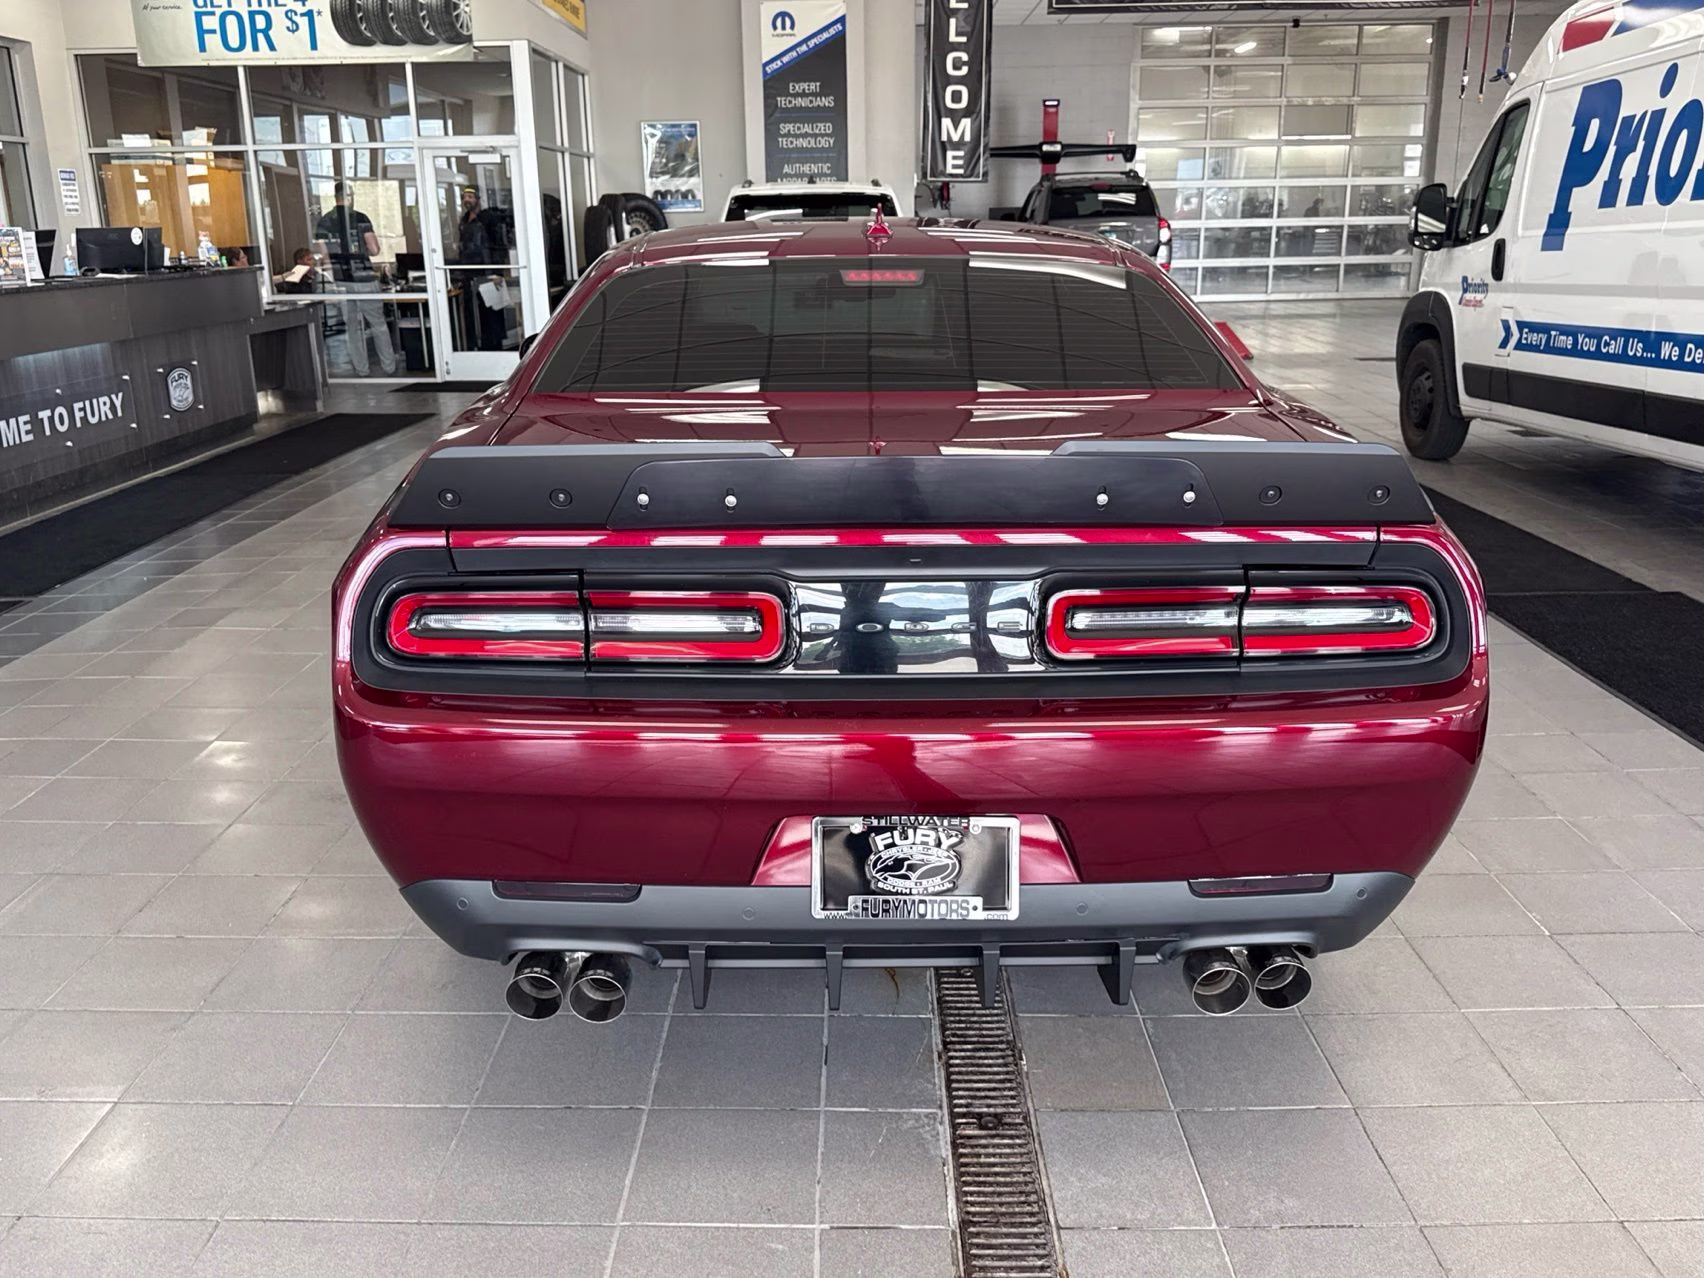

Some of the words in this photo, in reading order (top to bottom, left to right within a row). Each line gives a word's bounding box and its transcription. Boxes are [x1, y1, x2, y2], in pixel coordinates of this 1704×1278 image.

[194, 9, 276, 53] FOR
[765, 59, 784, 75] STICK
[780, 49, 799, 65] WITH
[796, 43, 809, 55] THE
[807, 22, 843, 49] SPECIALISTS
[789, 82, 821, 94] EXPERT
[776, 96, 834, 108] TECHNICIANS
[779, 122, 833, 135] SPECIALIZED
[778, 137, 835, 149] TECHNOLOGY
[783, 163, 831, 174] AUTHENTIC
[1521, 328, 1547, 350] Every
[1550, 330, 1573, 349] Time
[1577, 333, 1597, 351] You
[1601, 335, 1624, 354] Call
[1628, 338, 1656, 358] Us...
[1660, 340, 1679, 361] We
[1684, 343, 1704, 364] De
[0, 414, 34, 448] ME
[38, 406, 69, 436] TO
[73, 392, 124, 428] FURY
[874, 827, 963, 852] FURY
[877, 881, 910, 894] SOUTH
[928, 882, 954, 893] PAUL
[860, 899, 971, 918] FURYMOTORS
